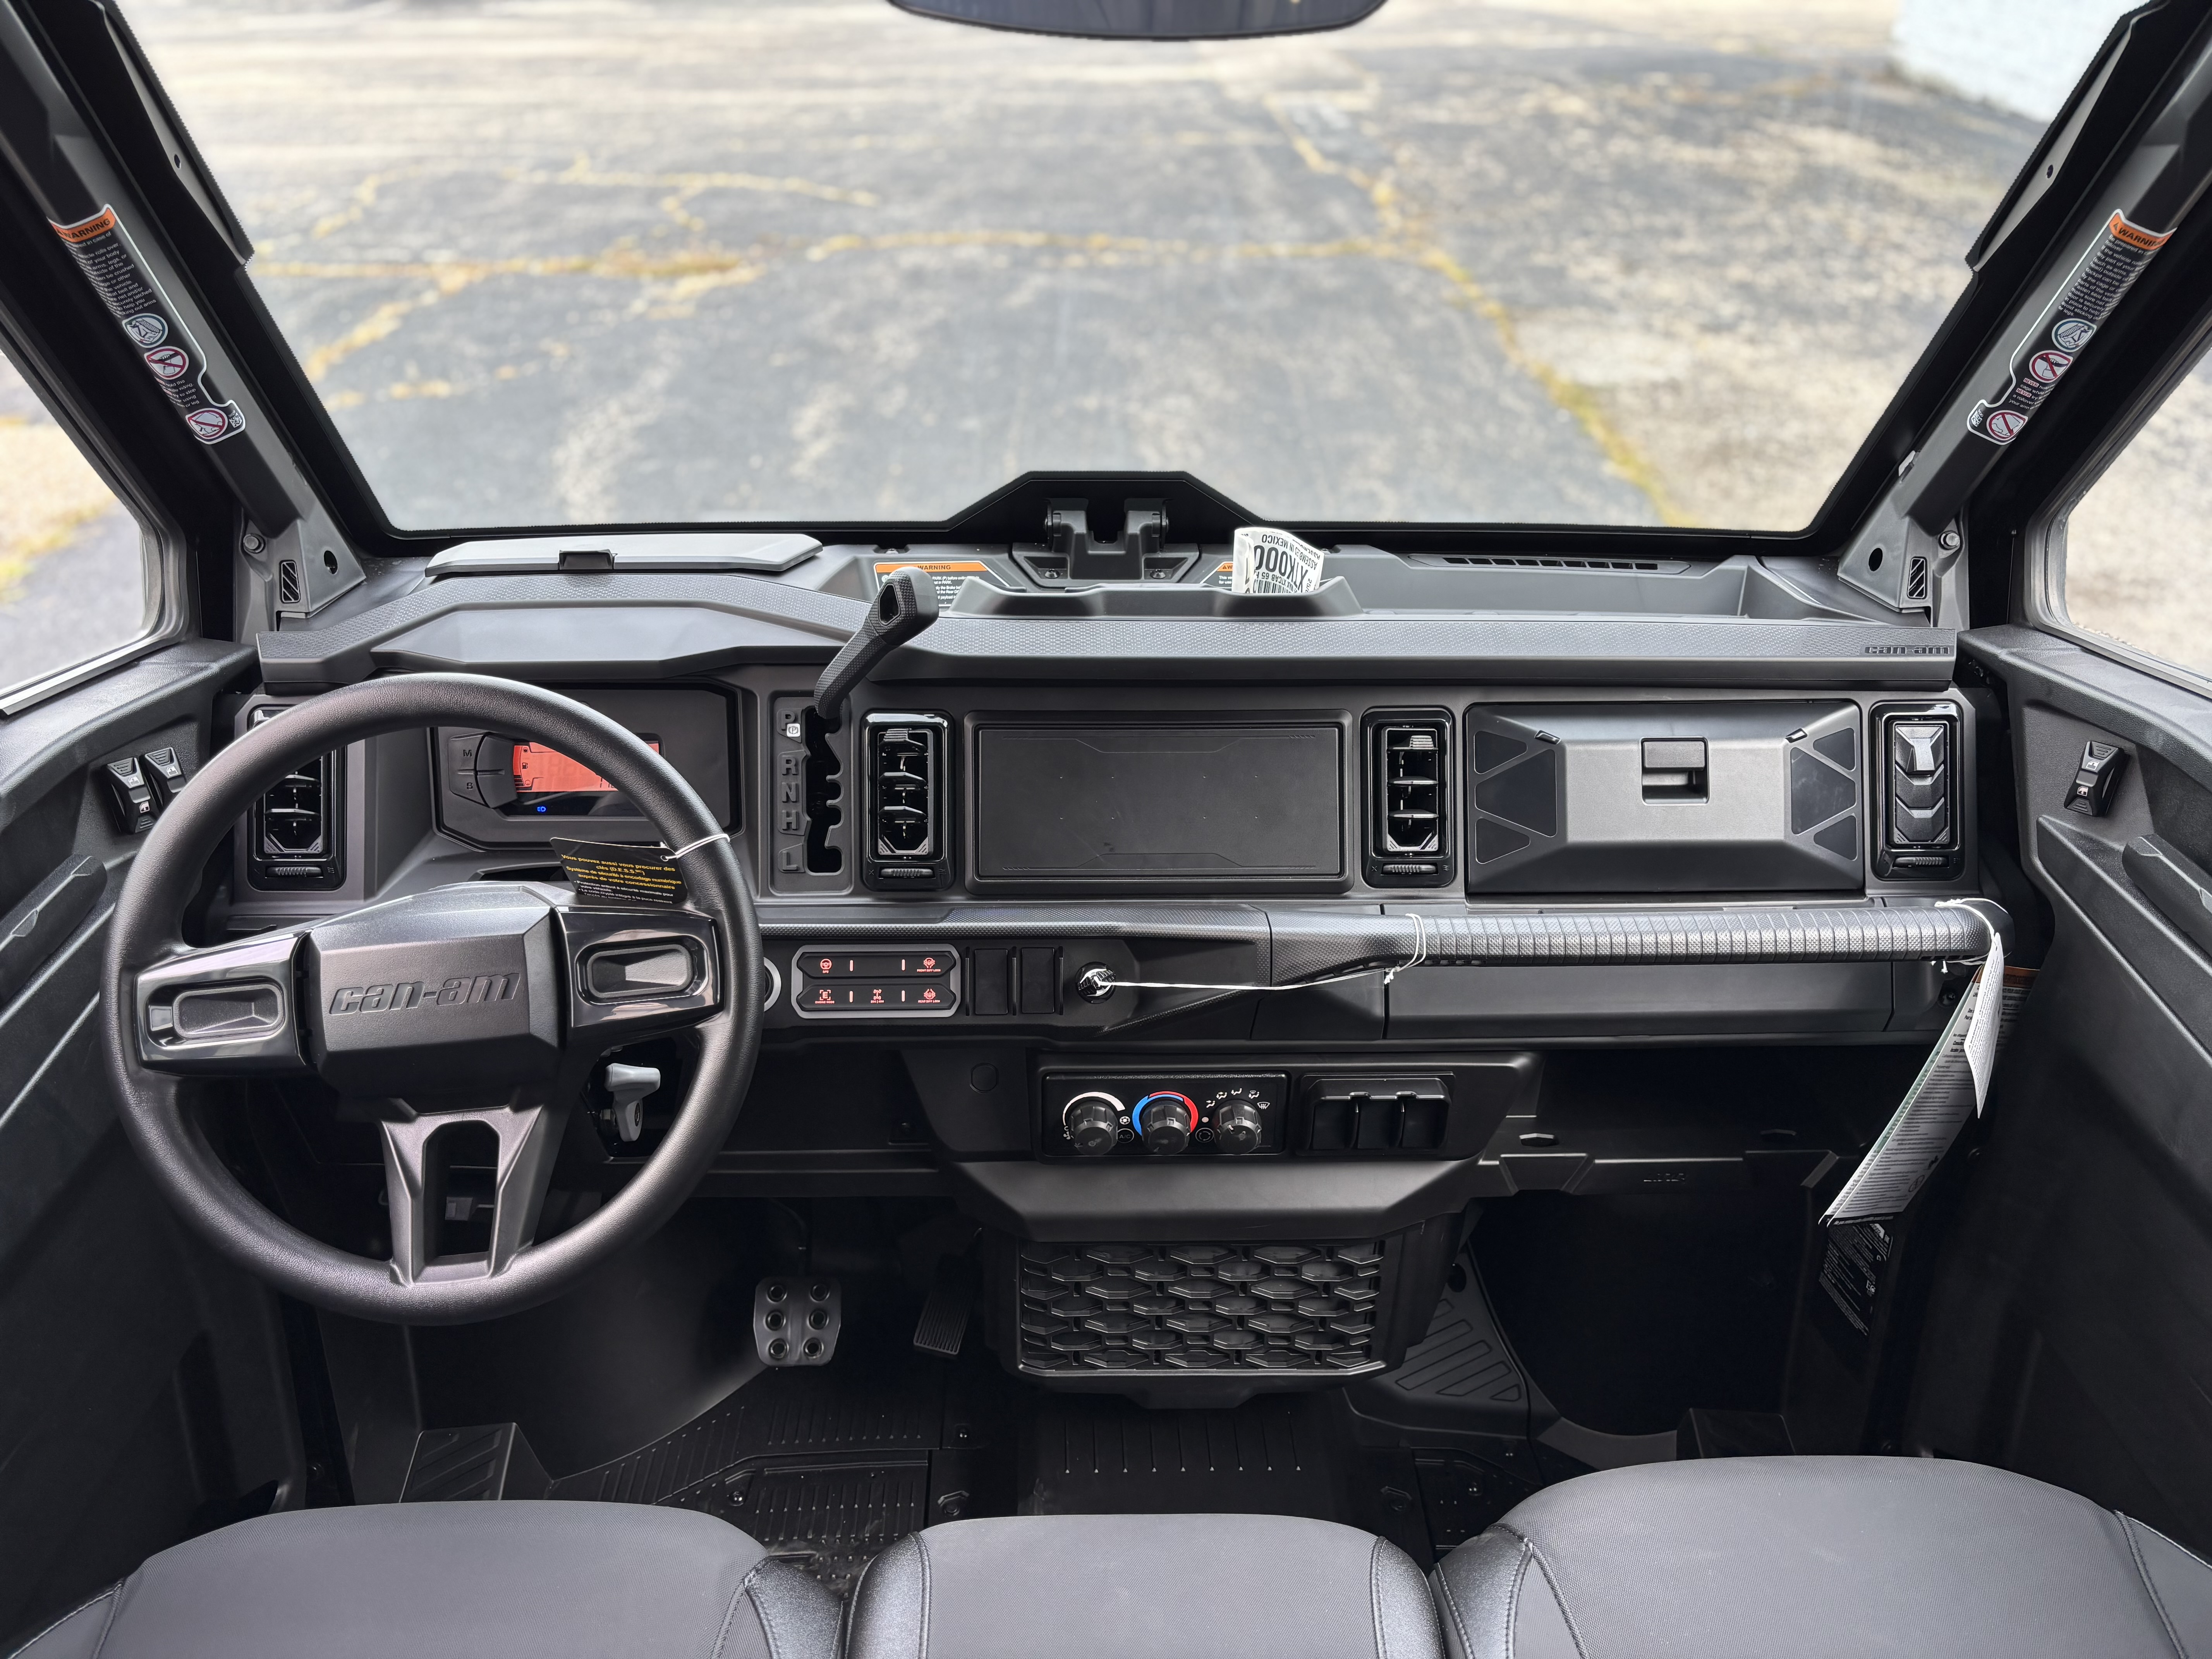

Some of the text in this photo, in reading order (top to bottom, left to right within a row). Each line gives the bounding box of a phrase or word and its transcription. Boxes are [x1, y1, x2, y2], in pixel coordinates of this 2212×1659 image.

[64, 218, 111, 239] WARNING
[2115, 239, 2139, 252] prepared
[106, 250, 120, 258] body
[2113, 253, 2131, 263] vehicle
[114, 264, 134, 275] crushed
[2086, 267, 2103, 279] cockpit
[117, 273, 131, 282] other
[2078, 278, 2090, 287] parts
[113, 280, 132, 289] vehicle
[2074, 282, 2090, 294] Fasten
[134, 288, 152, 299] latched
[2068, 292, 2079, 300] door
[2071, 287, 2084, 297] make
[2069, 299, 2083, 308] place
[2061, 301, 2093, 319] avoid sticking
[1262, 534, 1289, 549] MEXICO
[1290, 543, 1294, 553] IN
[1261, 572, 1269, 580] 65
[1865, 646, 1950, 654] can-am
[781, 710, 795, 731] P
[782, 756, 798, 775] R
[782, 782, 798, 803] N
[782, 810, 799, 831] H
[782, 851, 799, 871] L
[625, 881, 675, 890] concessionnaire
[328, 972, 521, 1016] can-am
